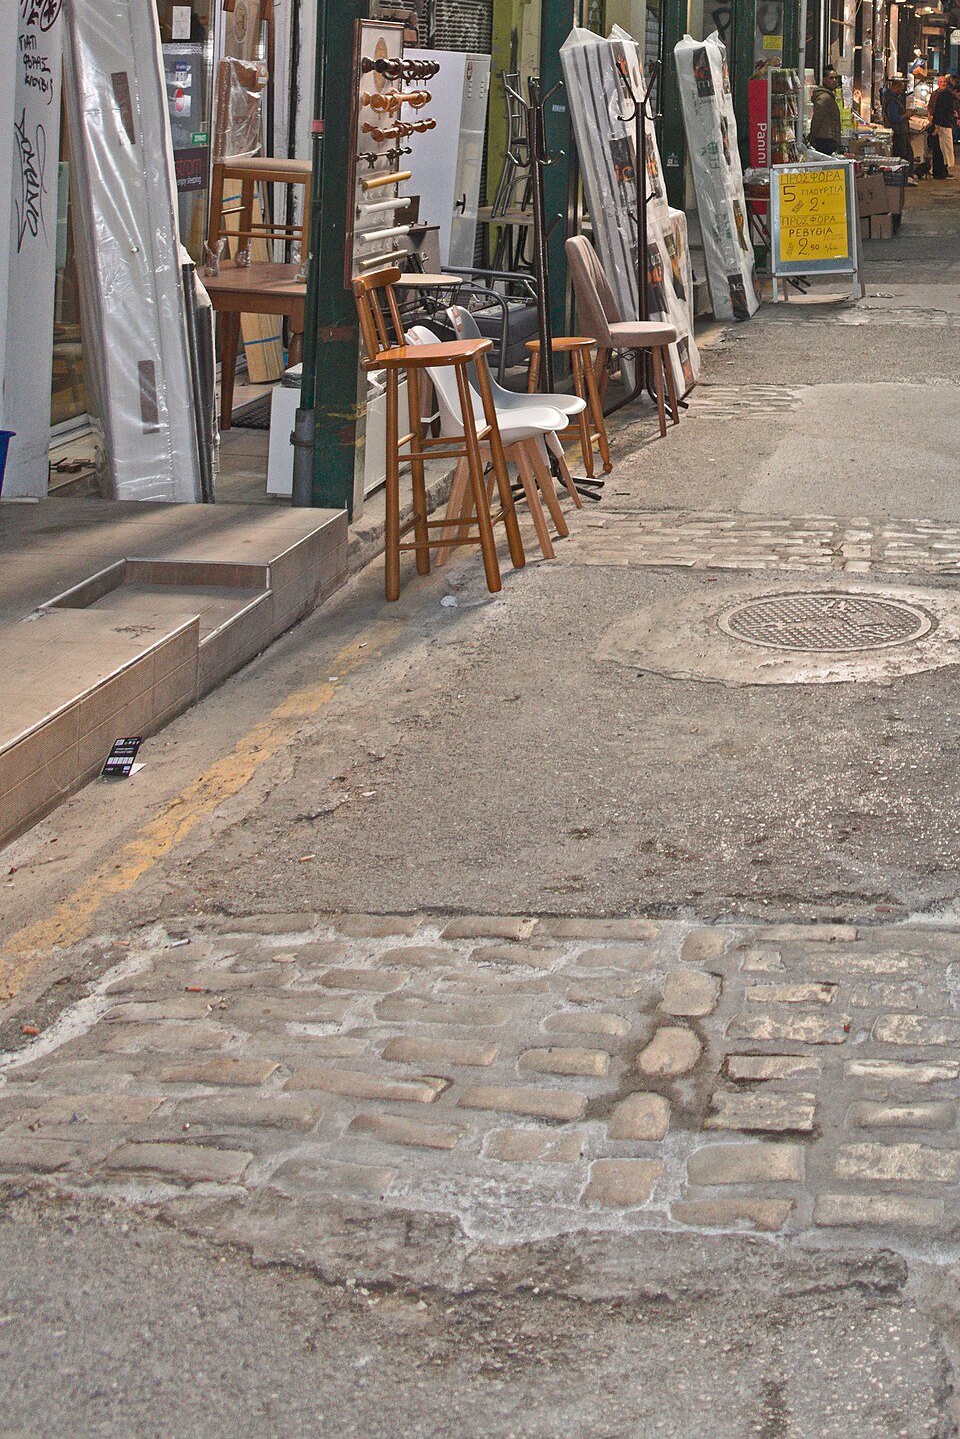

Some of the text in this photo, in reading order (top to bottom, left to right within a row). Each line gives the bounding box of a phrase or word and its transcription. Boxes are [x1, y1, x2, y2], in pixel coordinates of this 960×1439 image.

[756, 123, 768, 164] Panini
[781, 171, 841, 184] ΠΡΟΣΦΟΡΑ
[783, 185, 844, 203] 5 ΓΙΑΟΥΡΤΙΑ
[809, 197, 818, 212] 2
[782, 215, 836, 226] ΠΡΟΣΦΟΡΑ
[789, 227, 833, 238] ΡΕΒΥΘΙΑ
